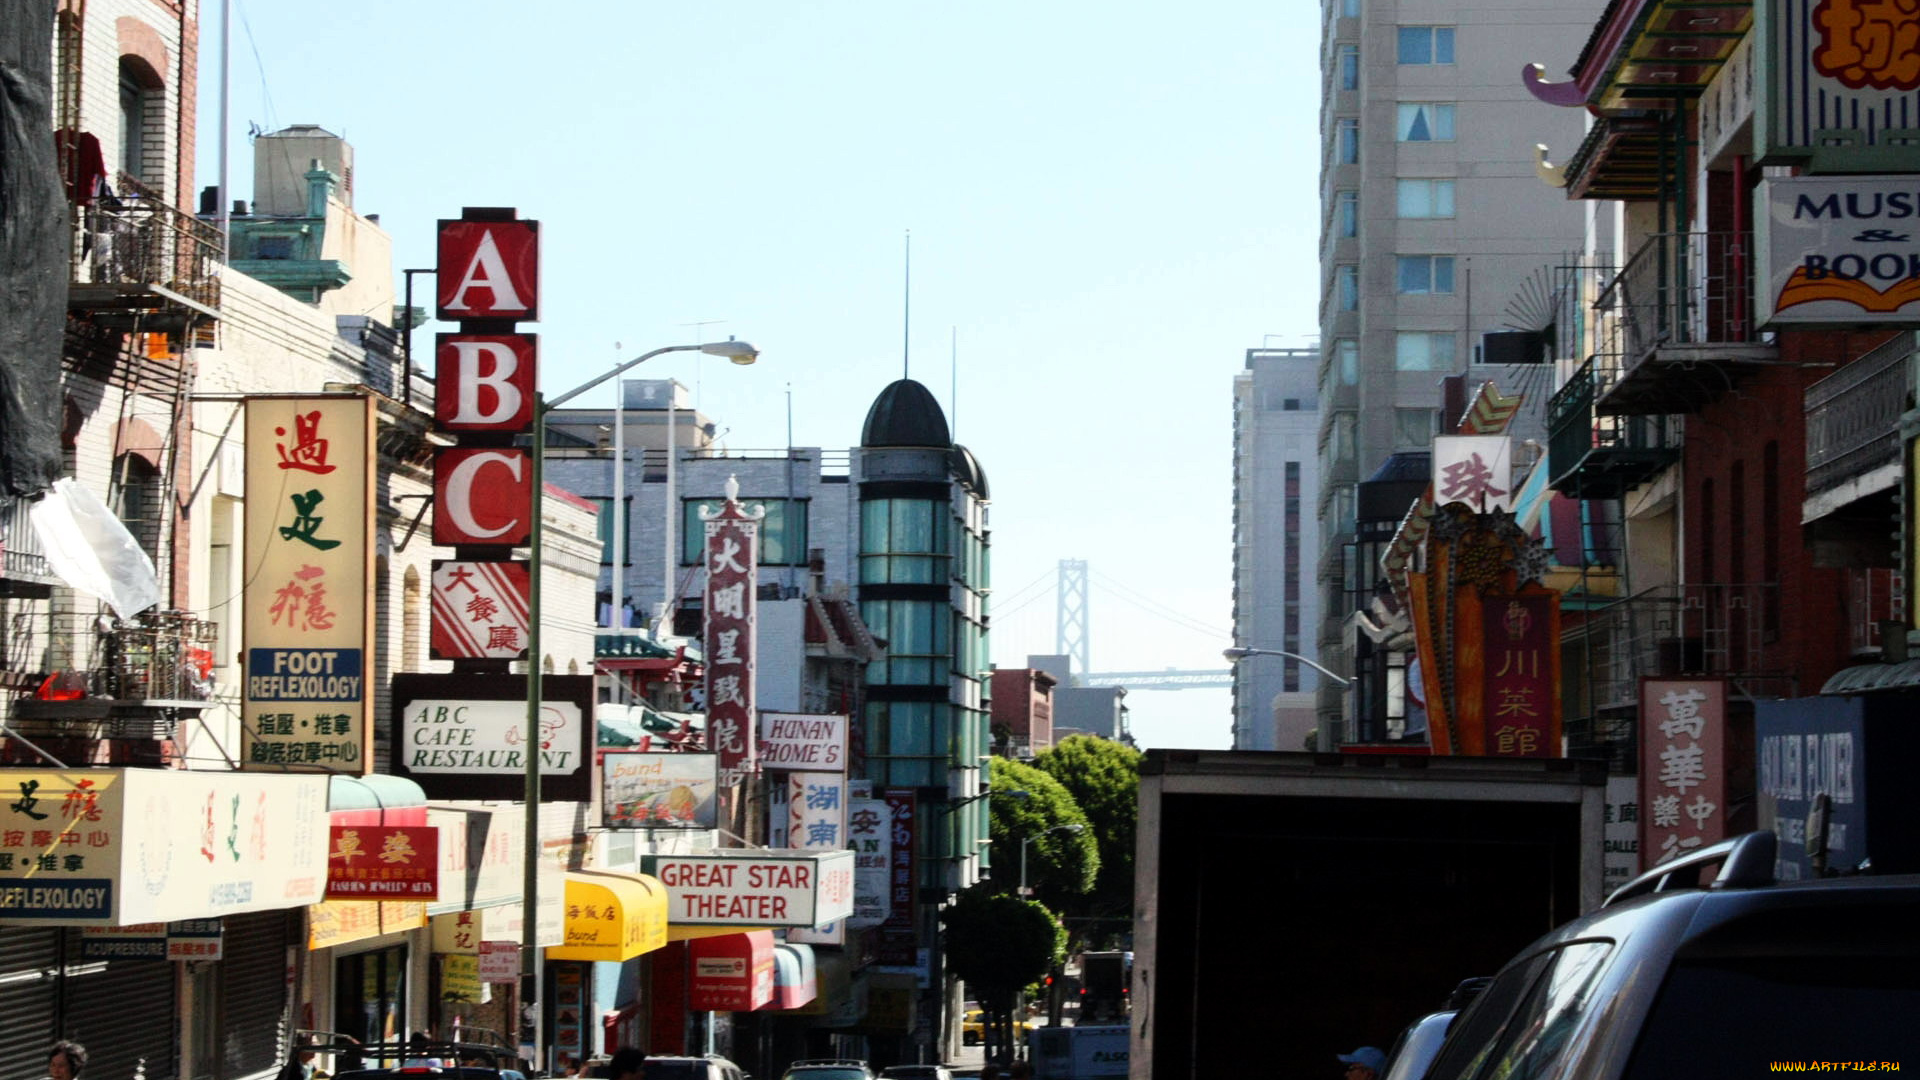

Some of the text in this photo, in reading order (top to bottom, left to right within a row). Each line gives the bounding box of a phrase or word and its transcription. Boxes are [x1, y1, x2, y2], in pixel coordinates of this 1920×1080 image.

[1793, 191, 1920, 219] MUS
[1852, 230, 1911, 242] &
[1440, 452, 1506, 506] 珠
[445, 565, 521, 652] 大餐廳
[273, 651, 338, 675] FOOT
[250, 675, 360, 699] REFLEXOLOGY
[1495, 650, 1542, 756] 川菜館
[413, 728, 475, 746] CAFE
[770, 720, 836, 740] HUNAN
[1659, 689, 1707, 795] 萬華
[765, 743, 840, 763] HOME'S
[805, 784, 840, 847] 湖南
[661, 864, 738, 887] GREAT
[748, 865, 811, 889] STAR
[682, 895, 788, 919] THEATER
[567, 929, 599, 941] bund
[85, 942, 164, 956] ACUPRESSURE
